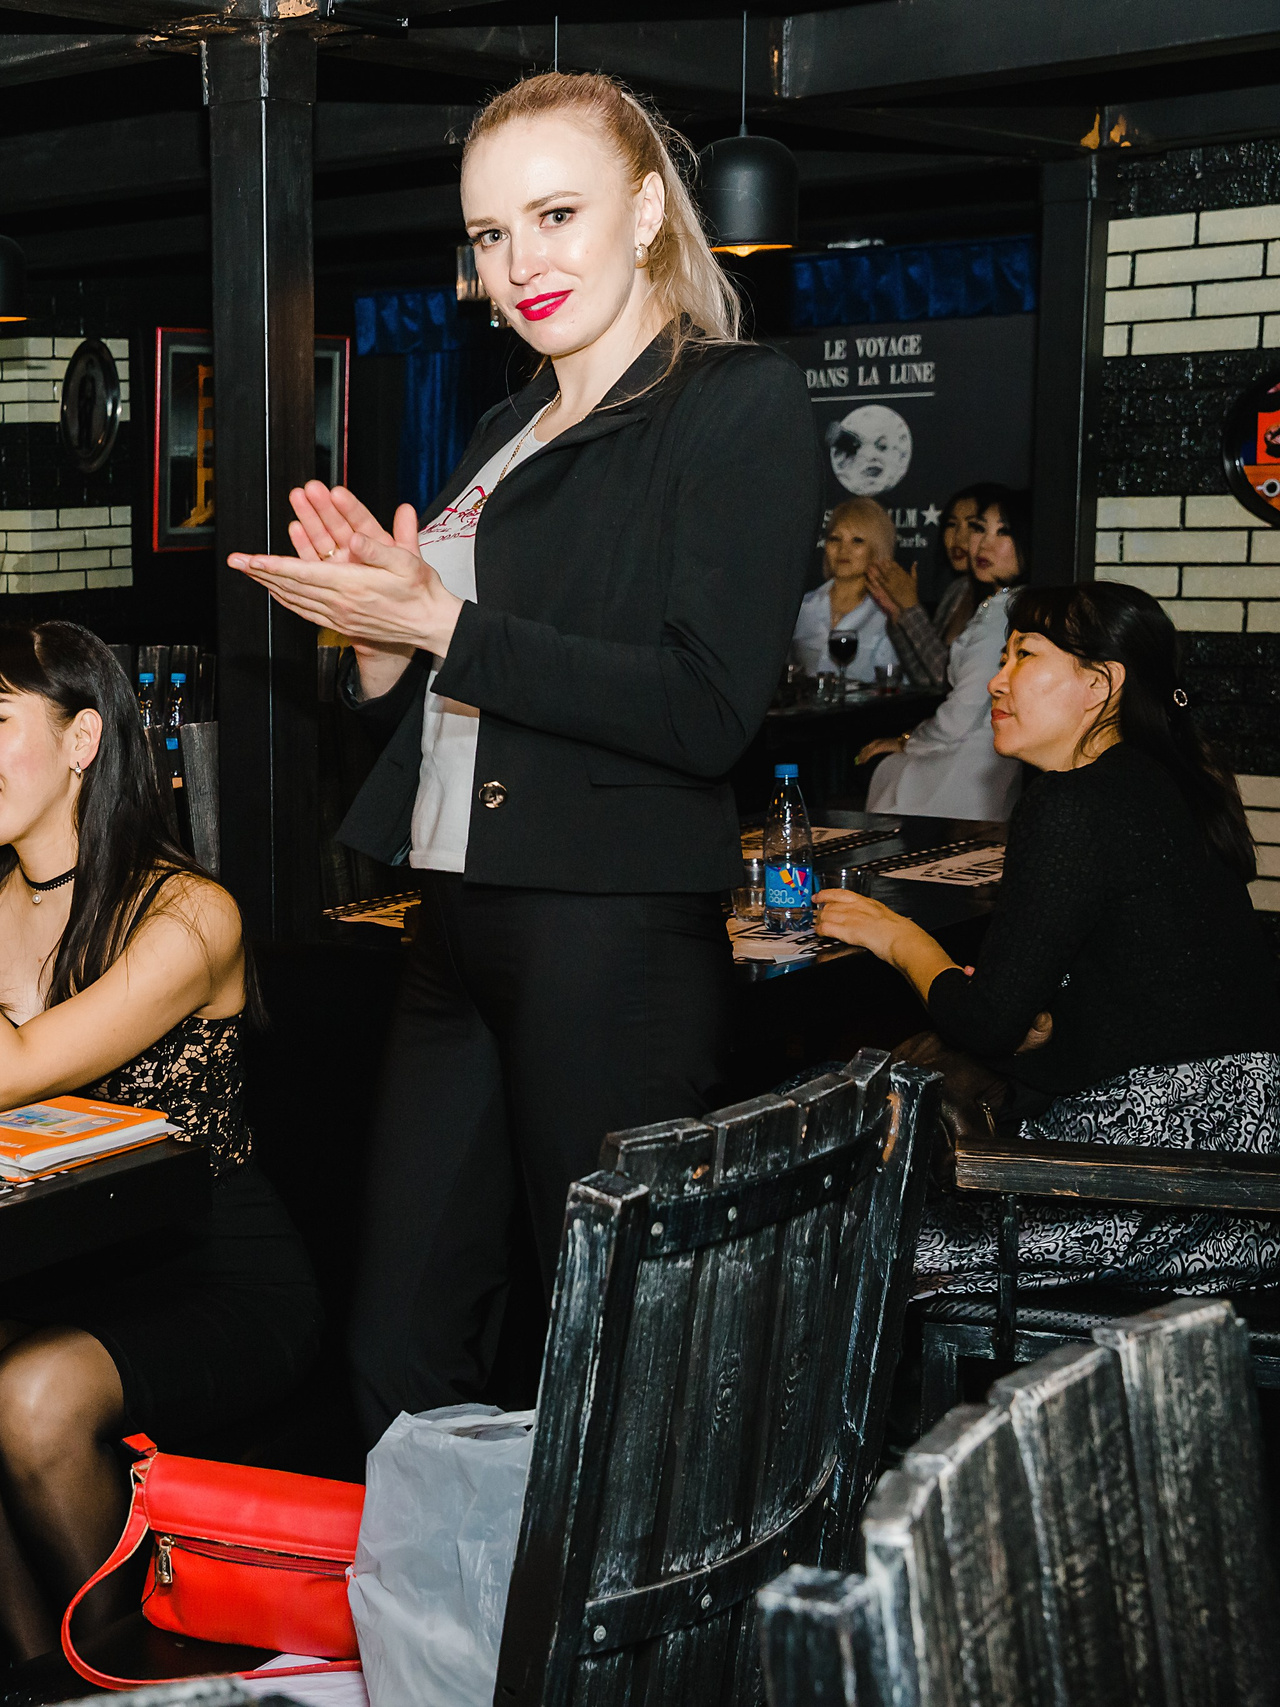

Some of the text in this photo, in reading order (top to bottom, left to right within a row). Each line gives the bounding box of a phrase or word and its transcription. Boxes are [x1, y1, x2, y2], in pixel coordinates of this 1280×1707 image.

[824, 334, 922, 361] LE VOYAGE
[807, 362, 935, 389] DANS LA LUNE
